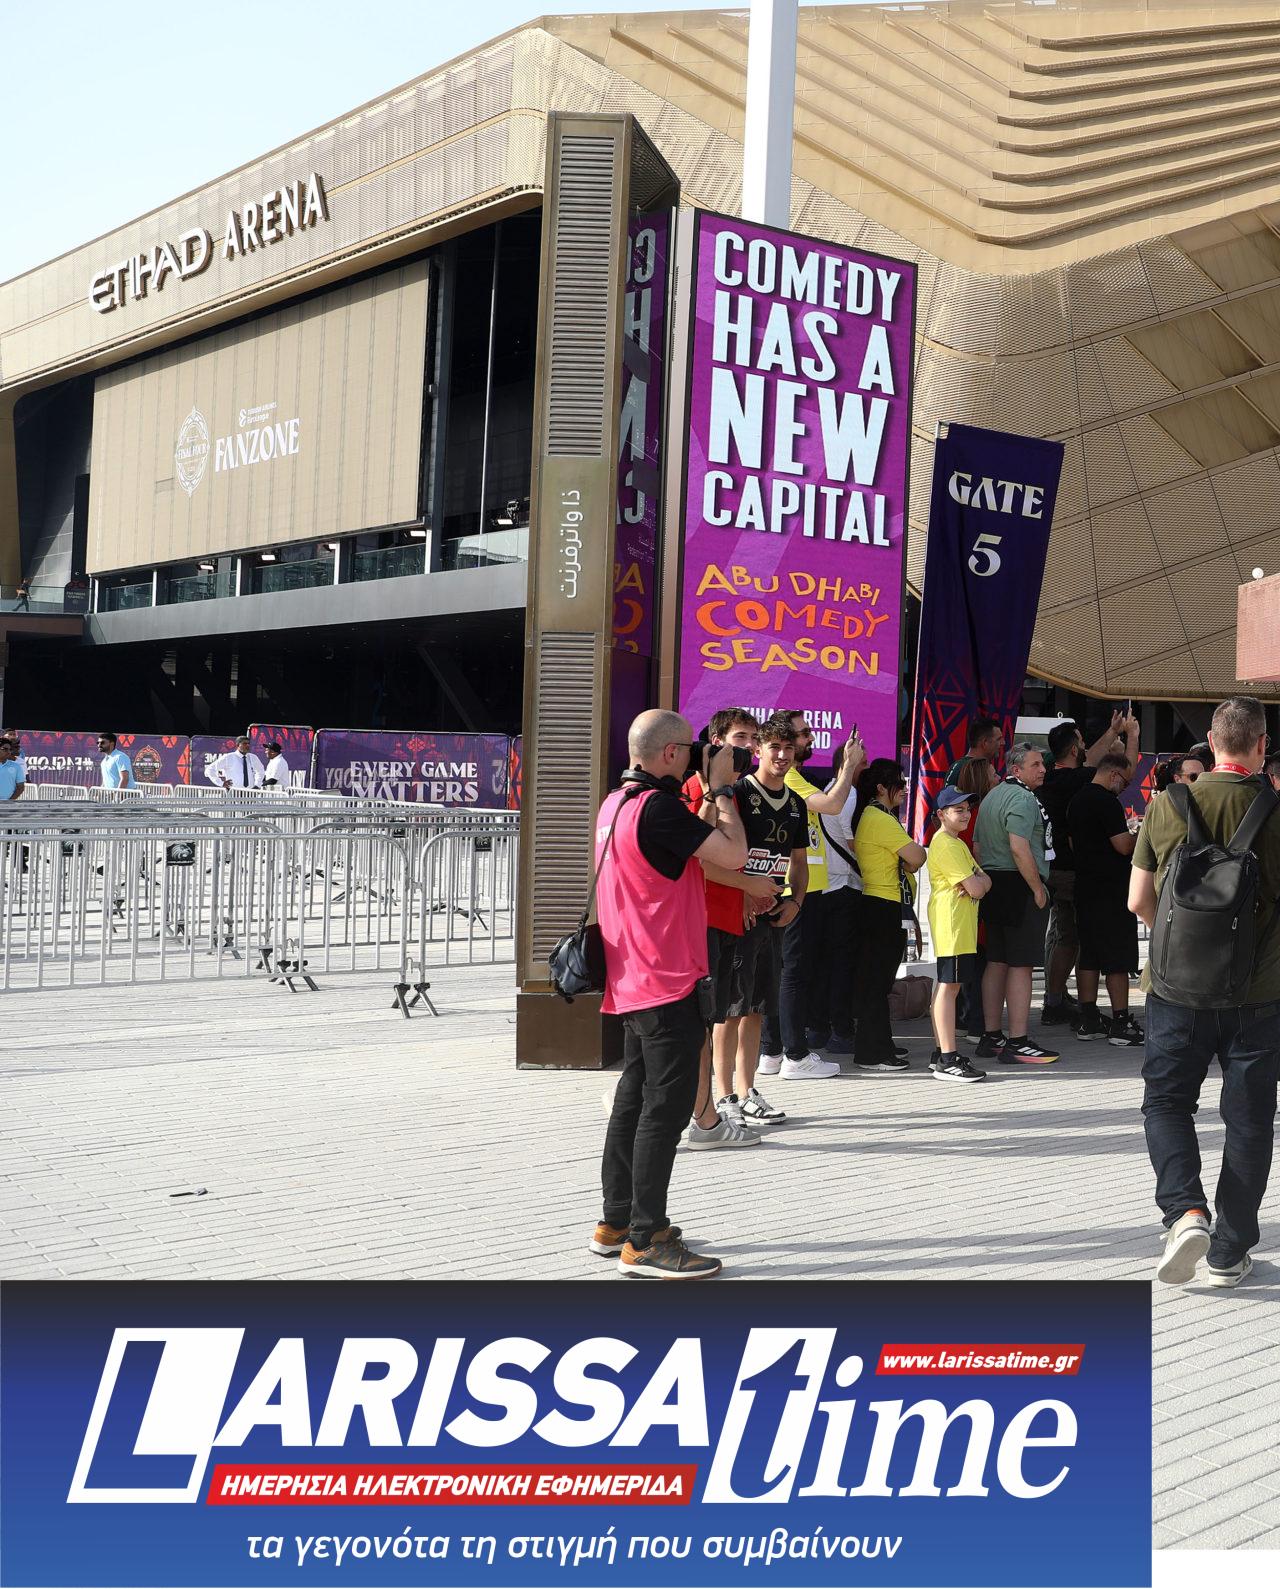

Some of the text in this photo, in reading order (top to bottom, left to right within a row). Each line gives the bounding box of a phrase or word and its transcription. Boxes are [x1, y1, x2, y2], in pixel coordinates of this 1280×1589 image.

[89, 171, 329, 313] ETIHAD ARENA
[714, 230, 901, 322] COMEDY
[712, 289, 838, 382] HAS
[858, 324, 895, 396] A
[215, 418, 300, 472] FANZONE
[708, 366, 890, 486] NEW
[703, 470, 890, 547] CAPITAL
[948, 470, 1045, 519] GATE
[968, 533, 1002, 577] 5
[696, 564, 880, 606] ABU DHABI
[695, 600, 890, 639] COMEDY
[700, 637, 879, 676] SEASON
[797, 709, 843, 730] RENA
[350, 761, 418, 779] EVERY
[421, 761, 478, 779] GAME
[352, 781, 479, 802] MATTERS
[764, 818, 788, 843] 26
